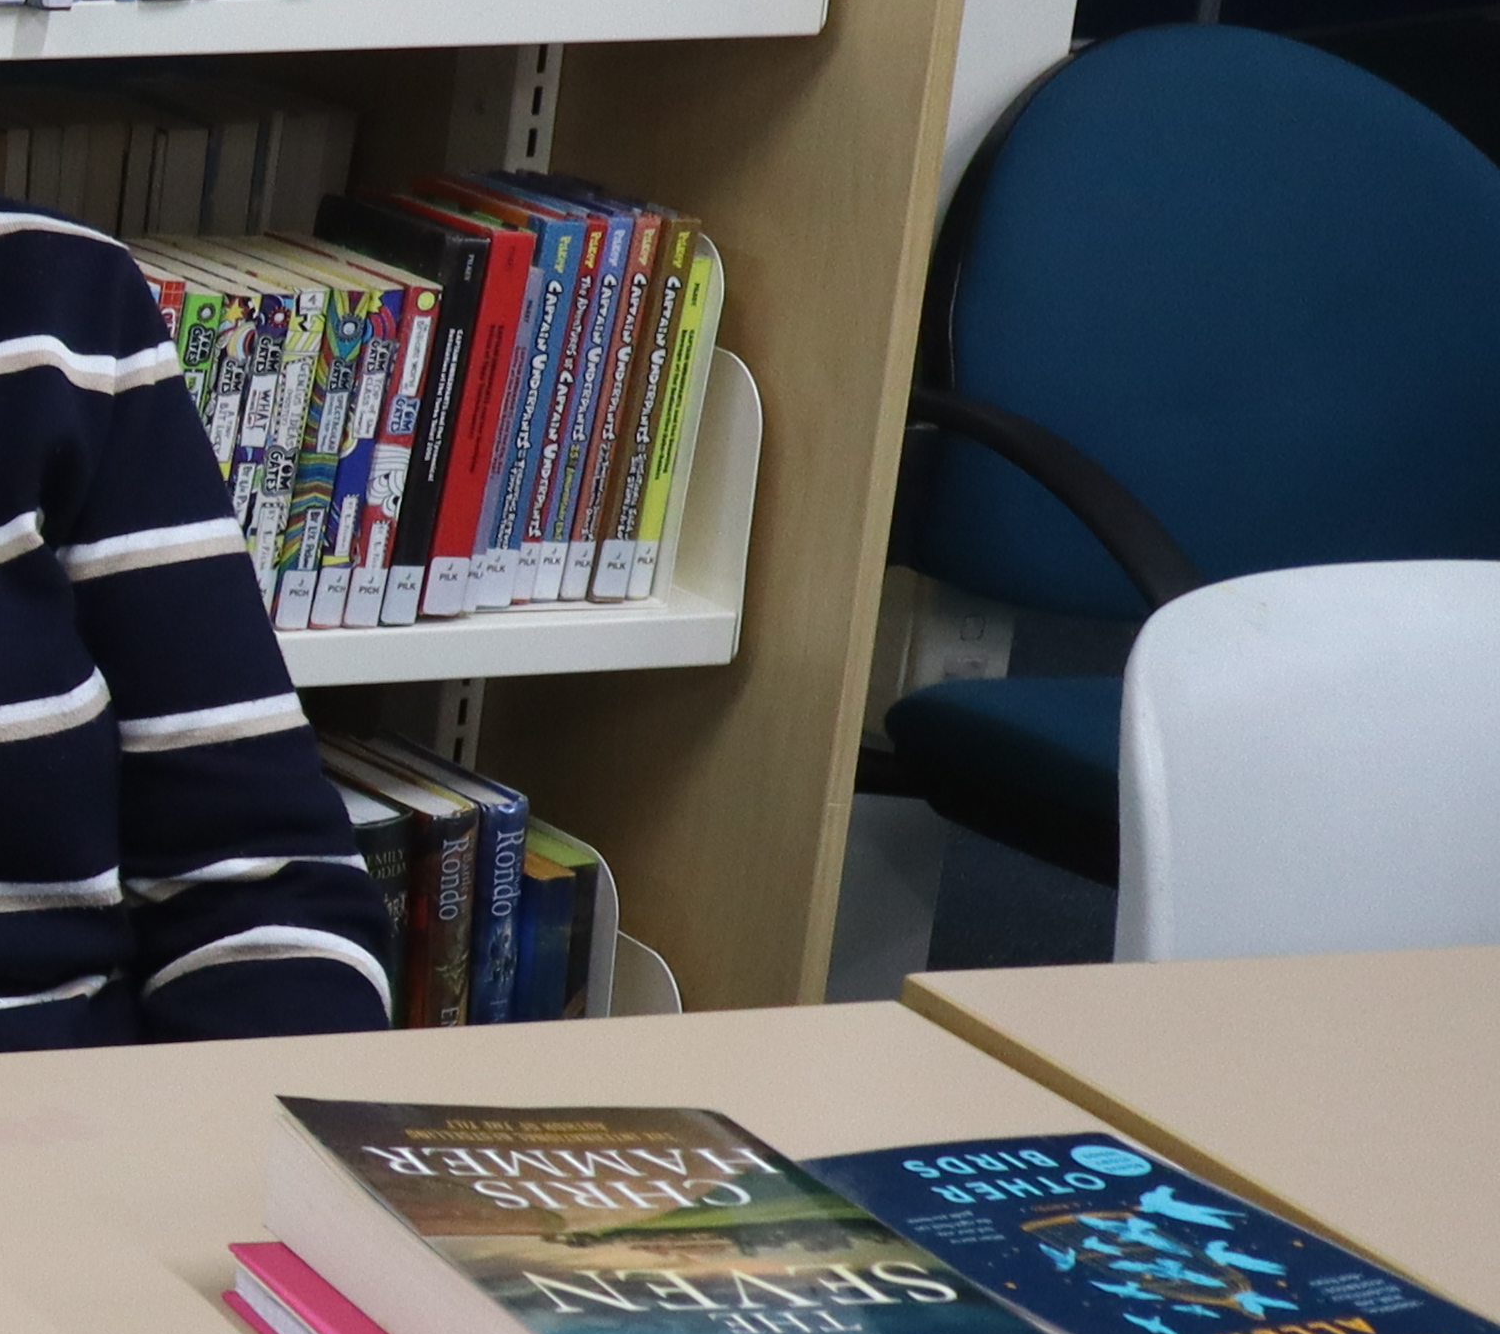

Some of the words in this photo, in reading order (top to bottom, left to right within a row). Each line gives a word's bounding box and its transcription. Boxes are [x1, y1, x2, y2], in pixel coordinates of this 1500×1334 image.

[439, 839, 469, 921] Rondo
[492, 829, 524, 918] Rondo
[363, 1146, 781, 1178] HAMMER
[902, 1149, 1059, 1179] BIRDS
[473, 1179, 752, 1210] CHRIS
[931, 1173, 1106, 1205] OTHER
[522, 1262, 958, 1314] SEVEN
[718, 1310, 862, 1334] THE
